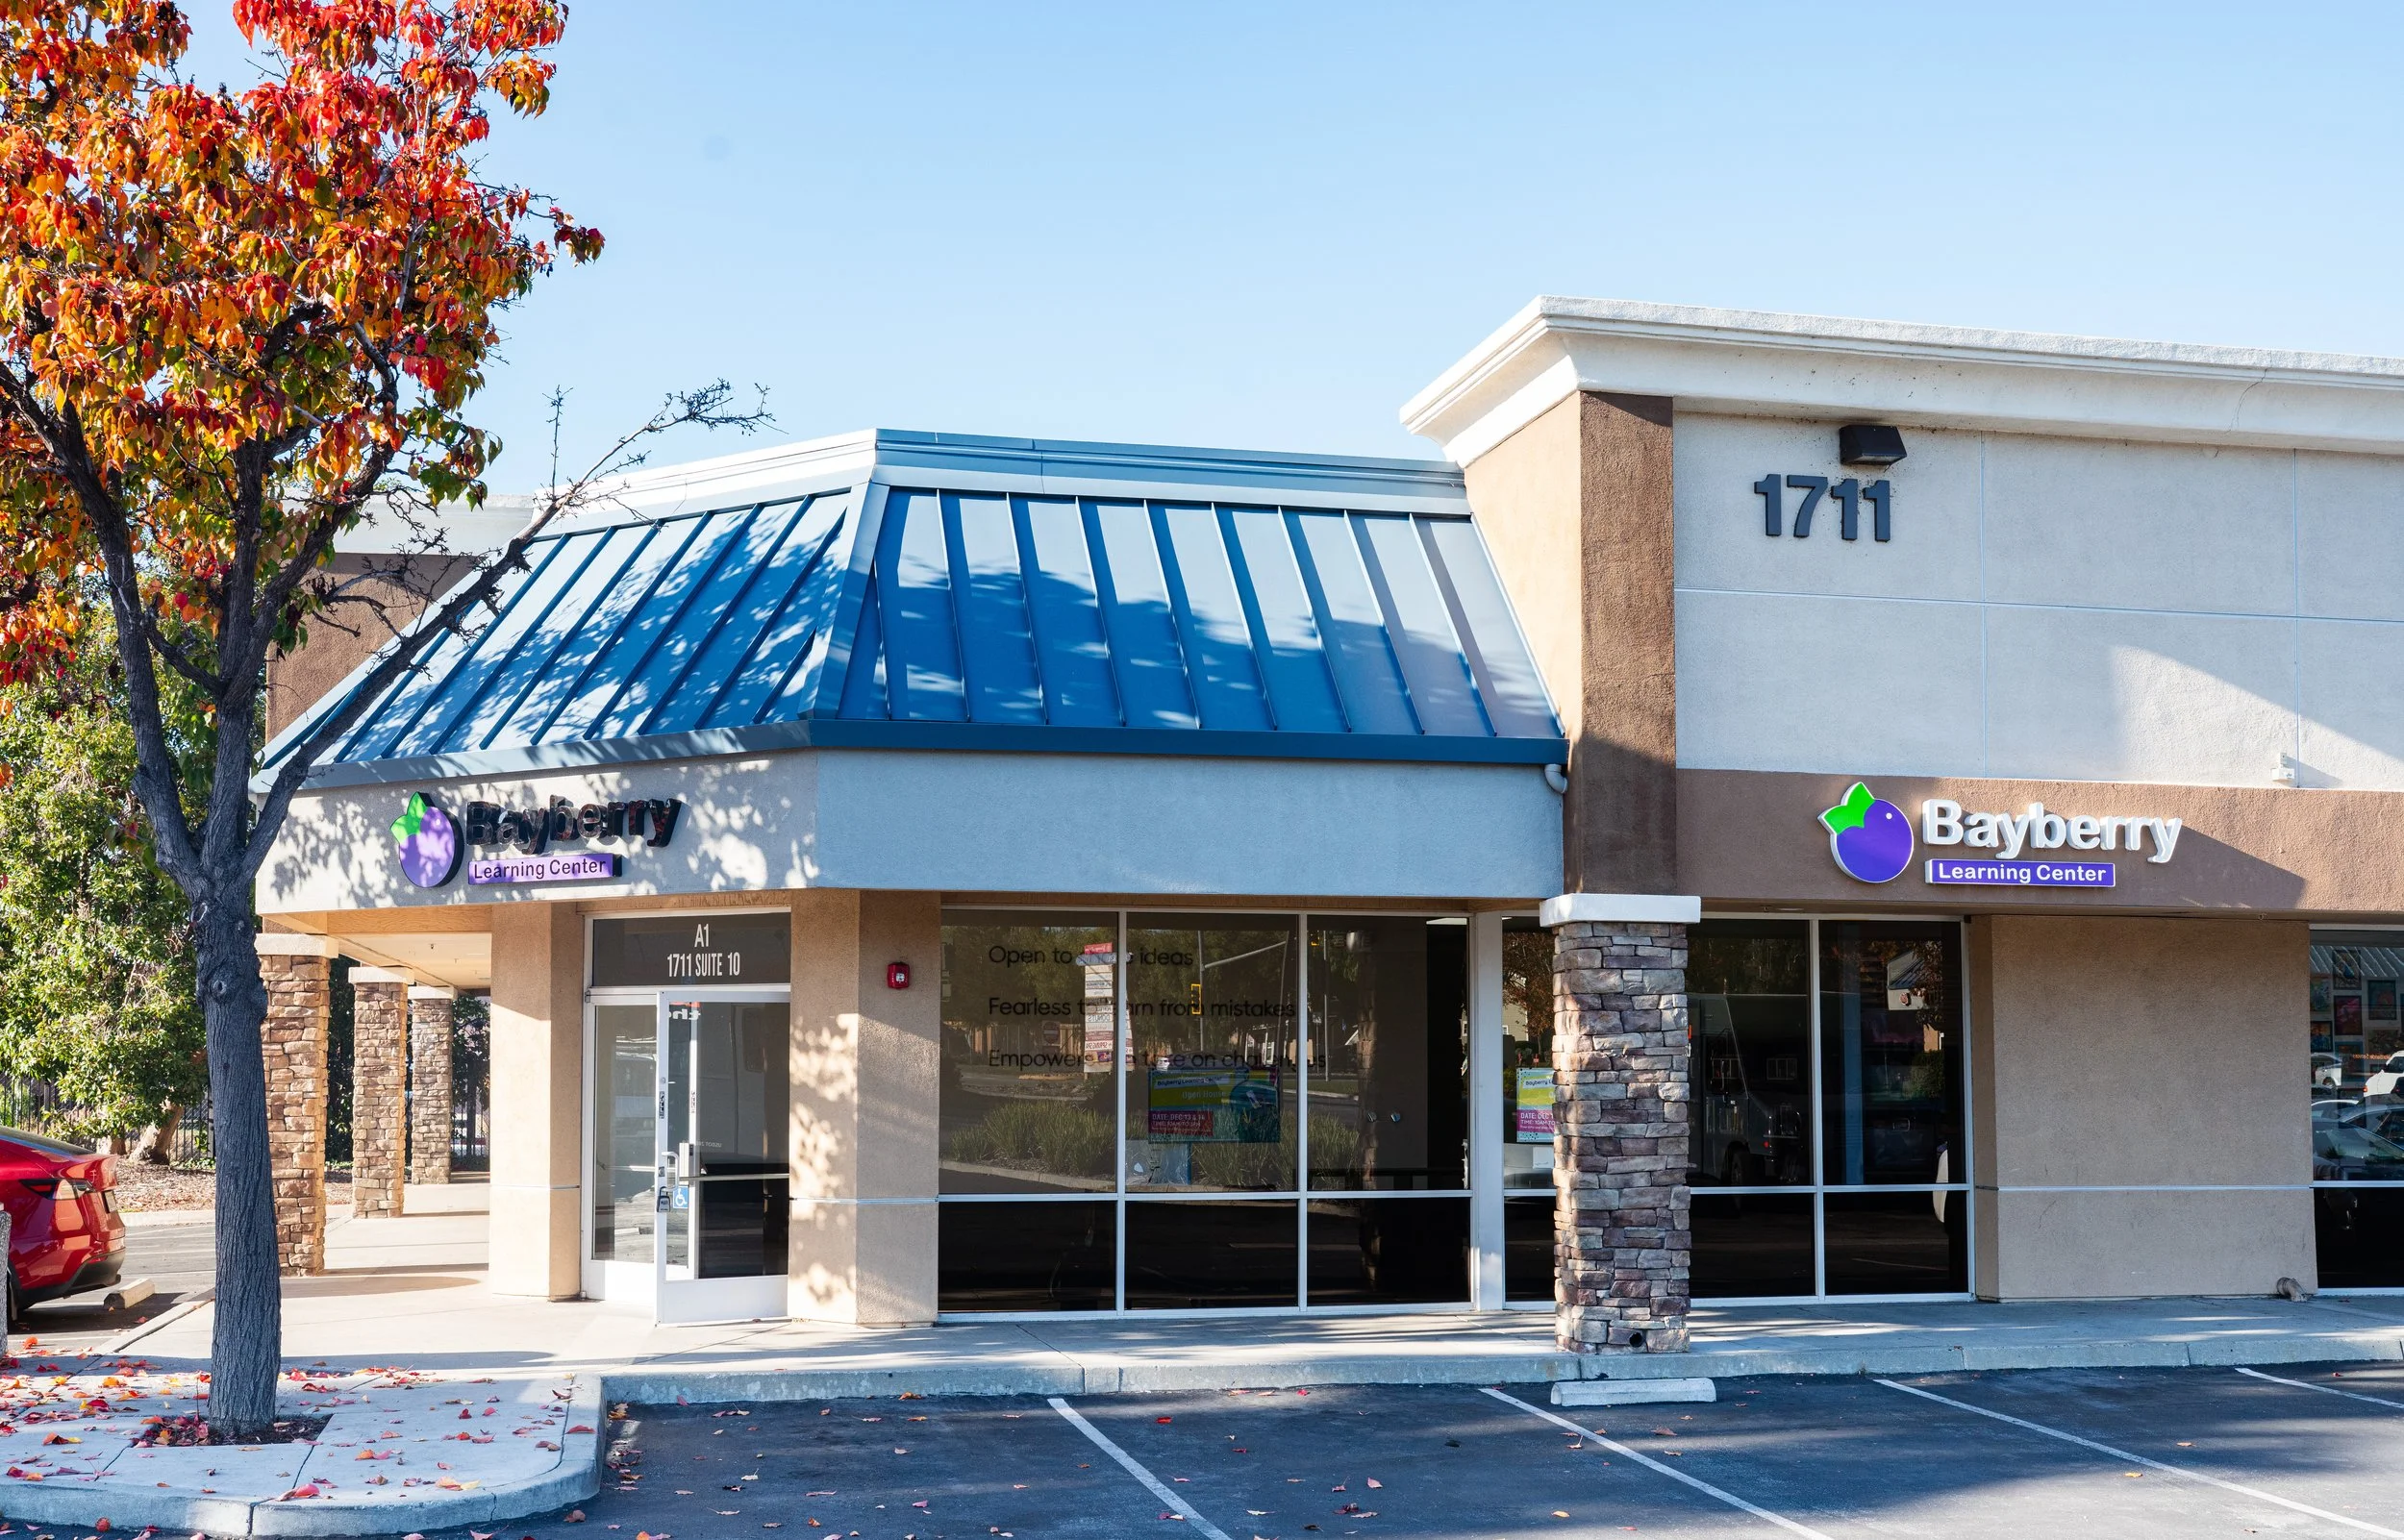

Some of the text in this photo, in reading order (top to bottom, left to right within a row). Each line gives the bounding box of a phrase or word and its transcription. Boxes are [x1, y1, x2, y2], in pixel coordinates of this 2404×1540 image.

[1754, 473, 1891, 543] 1711
[466, 794, 682, 855] Bayberry
[1922, 799, 2183, 864] Bayberry
[474, 857, 607, 880] Learning Center
[1938, 862, 2107, 883] Learning Center
[693, 923, 711, 948] A1
[666, 952, 740, 978] 1711 SUITE 10
[988, 945, 1046, 968] Open
[1051, 947, 1073, 965] to
[1139, 948, 1193, 966] ideas
[988, 997, 1071, 1016] Fearless
[1159, 998, 1205, 1017] from
[1211, 999, 1297, 1018] mistakes
[1190, 1053, 1216, 1068] on
[1182, 1091, 1202, 1100] Open
